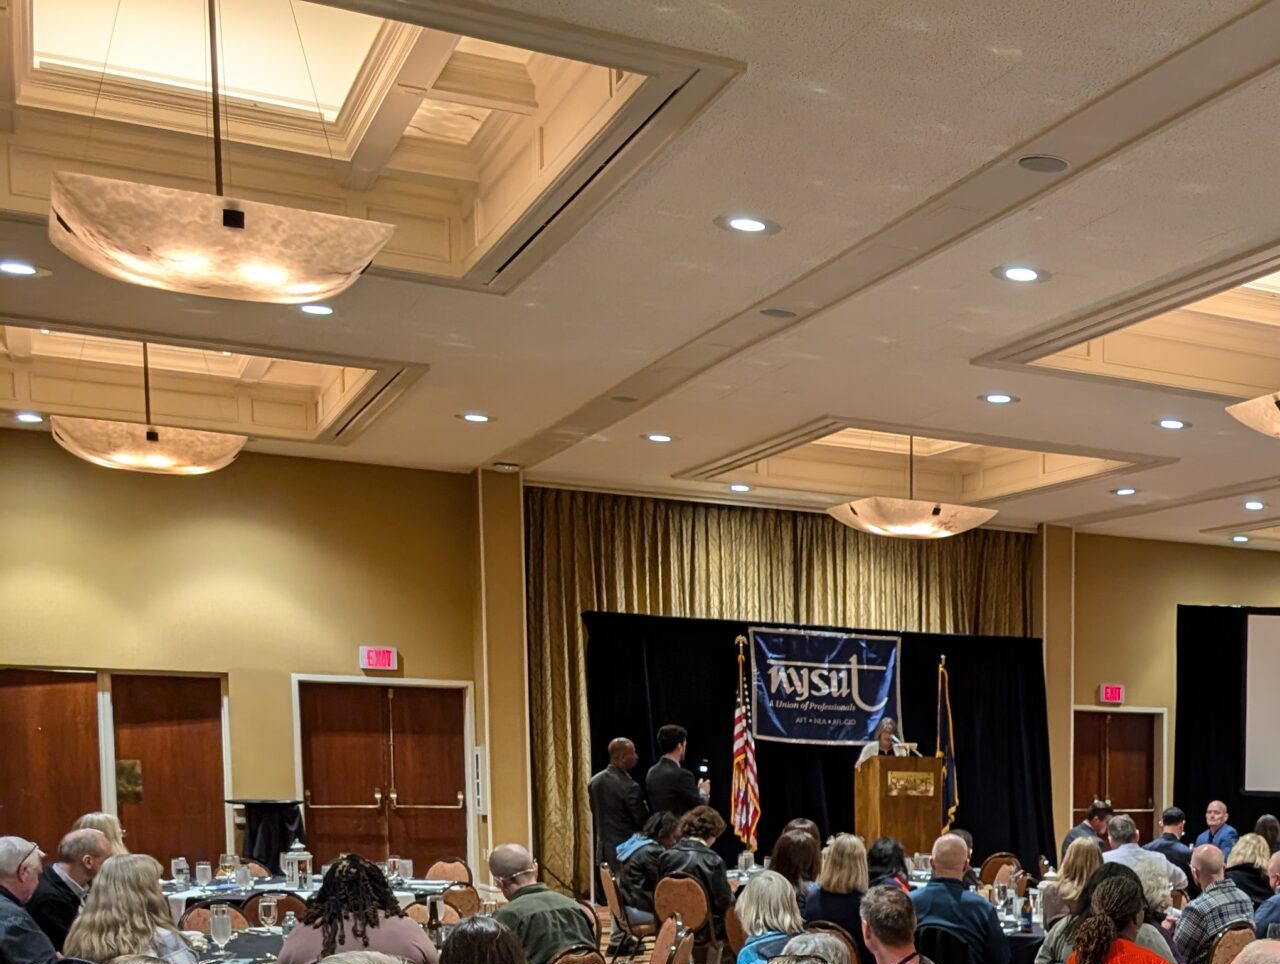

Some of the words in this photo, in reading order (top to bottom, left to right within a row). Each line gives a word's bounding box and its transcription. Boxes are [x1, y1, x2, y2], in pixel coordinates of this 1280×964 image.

[367, 649, 392, 667] EXIT
[767, 654, 888, 712] nysut
[1105, 686, 1121, 701] EXIT
[776, 700, 799, 709] Union
[800, 701, 809, 711] of
[809, 702, 856, 712] Professionals
